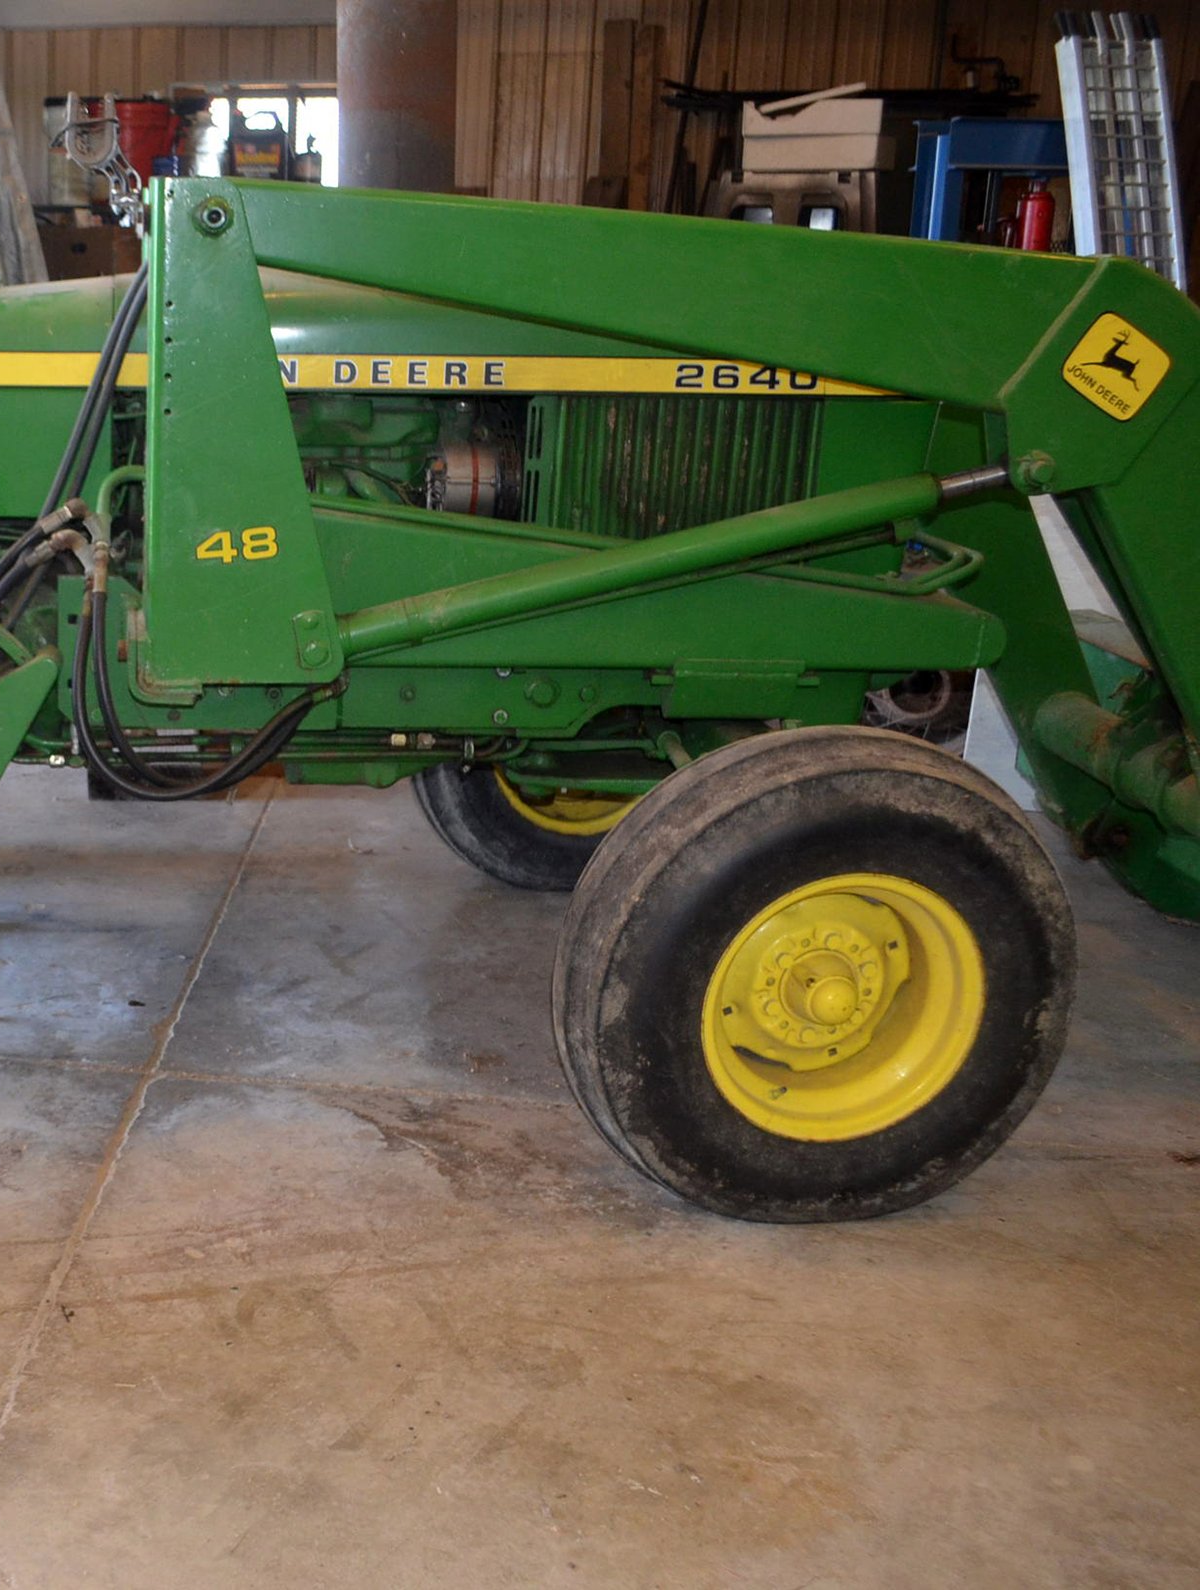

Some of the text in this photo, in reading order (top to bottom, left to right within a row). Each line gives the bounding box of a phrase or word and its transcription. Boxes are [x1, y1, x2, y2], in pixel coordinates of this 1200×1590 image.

[333, 359, 504, 386] DEERE
[675, 364, 818, 390] 2640
[1067, 365, 1131, 414] JOHN DEERE
[196, 525, 278, 564] 48
